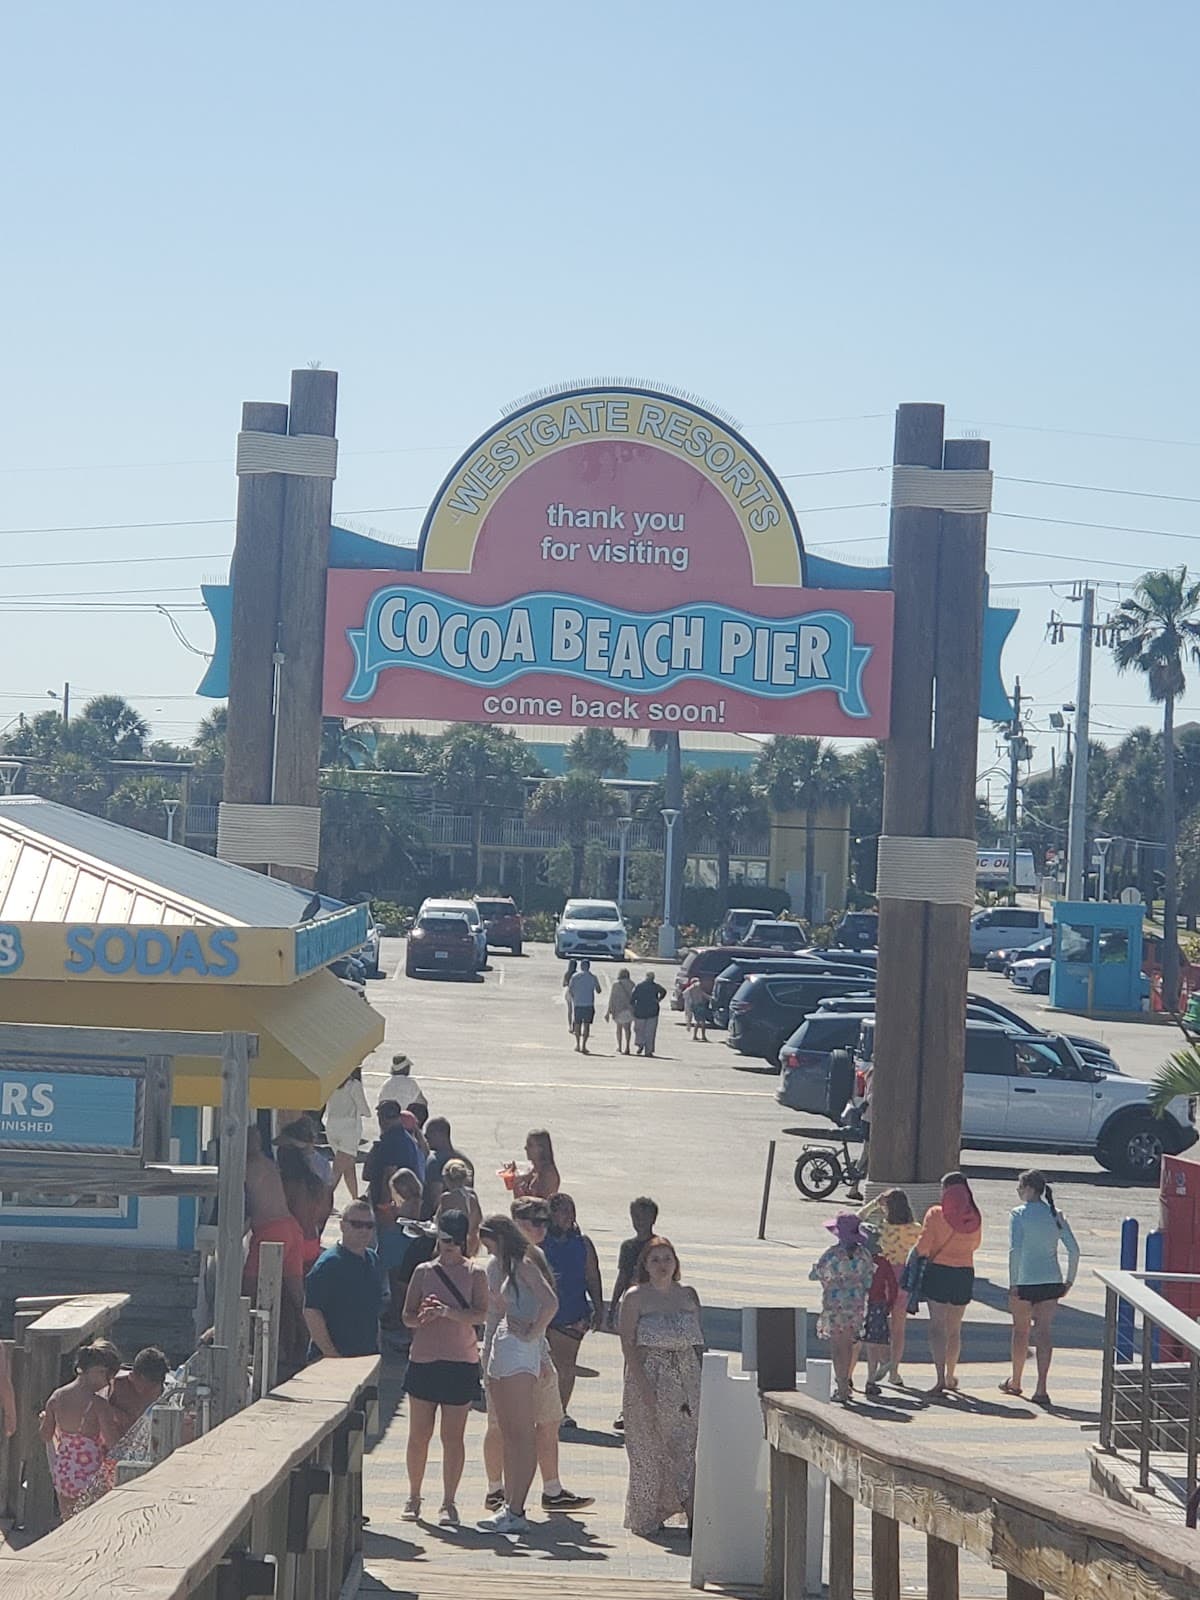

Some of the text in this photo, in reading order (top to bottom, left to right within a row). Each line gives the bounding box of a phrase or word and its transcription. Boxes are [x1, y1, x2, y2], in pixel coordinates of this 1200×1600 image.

[447, 400, 781, 533] WESTGATE RESORTS
[546, 503, 686, 536] thank you
[540, 537, 690, 573] for visiting
[377, 597, 832, 686] COCOA BEACH PIER
[483, 694, 727, 723] come back soon!
[64, 927, 240, 977] SODAS
[0, 1120, 53, 1133] INISHED
